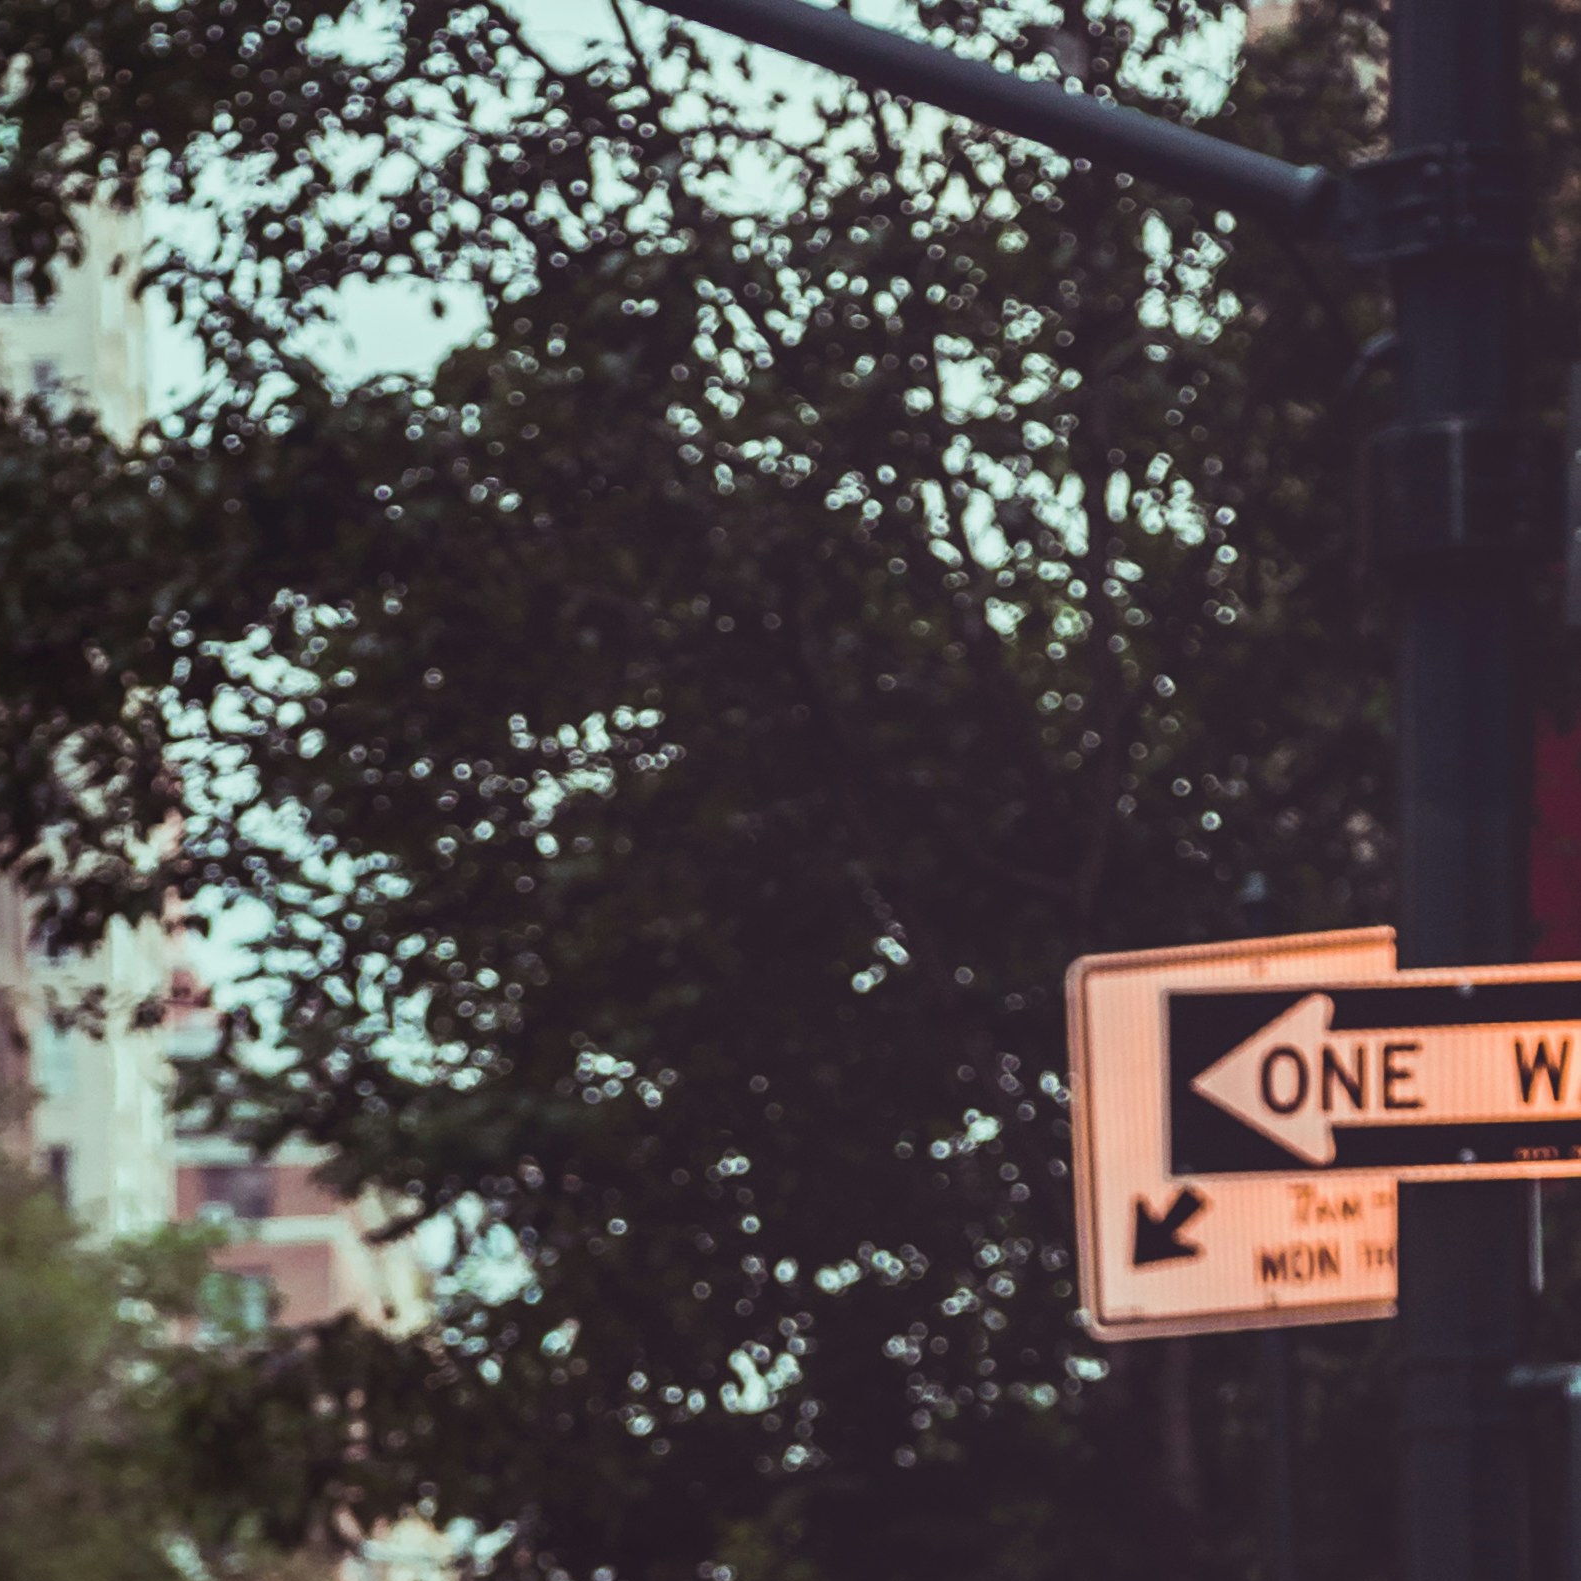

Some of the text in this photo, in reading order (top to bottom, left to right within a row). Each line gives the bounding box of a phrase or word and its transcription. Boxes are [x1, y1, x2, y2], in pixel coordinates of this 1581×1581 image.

[1260, 1039, 1570, 1115] ONE W
[1256, 1243, 1341, 1283] MON
